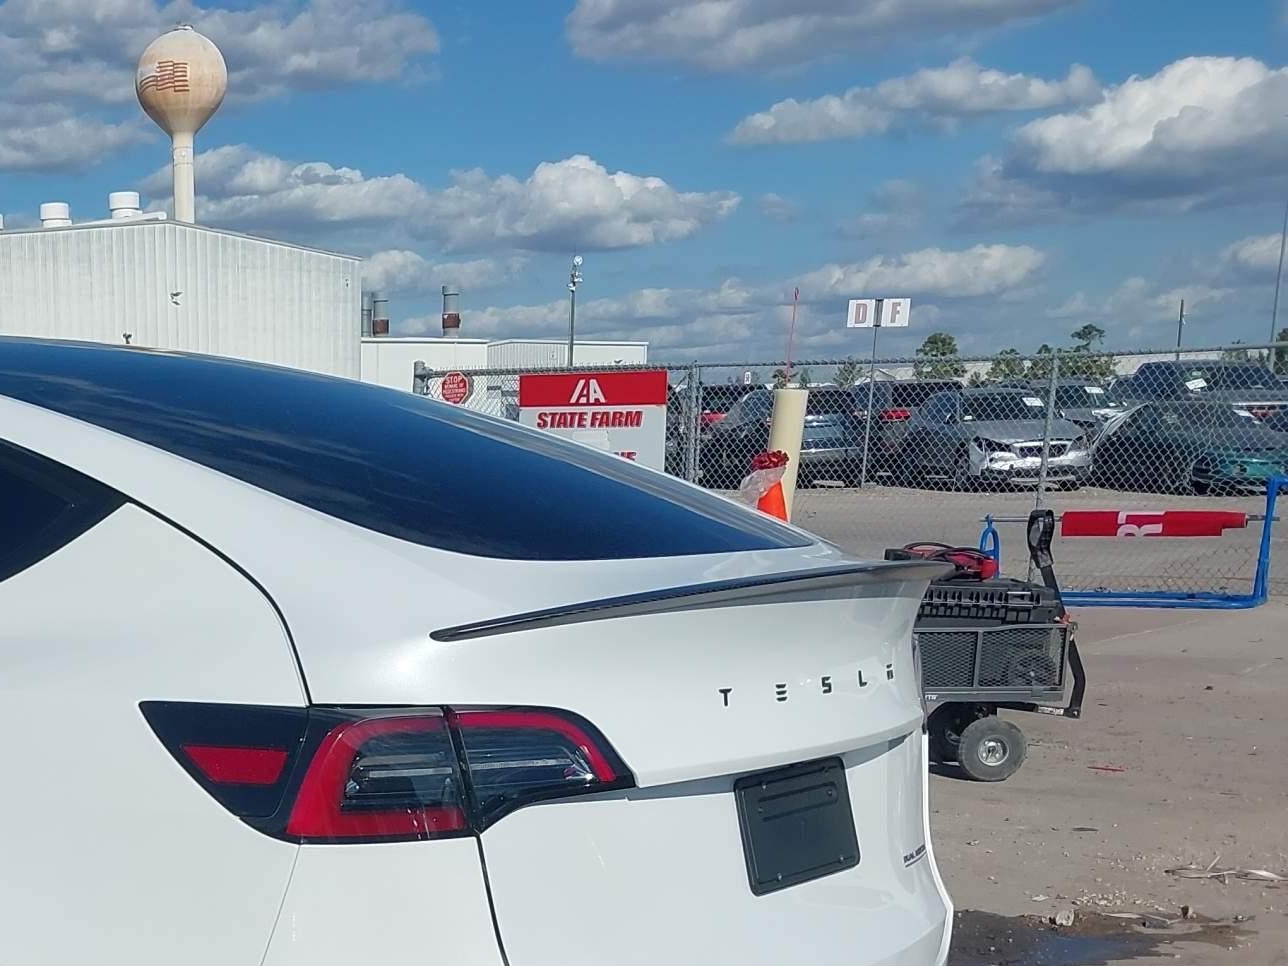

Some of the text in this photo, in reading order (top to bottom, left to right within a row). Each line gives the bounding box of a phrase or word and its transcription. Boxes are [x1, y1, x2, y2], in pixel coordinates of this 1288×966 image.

[854, 301, 902, 324] D F
[445, 375, 463, 385] STOP
[536, 410, 643, 429] STATE FARM
[718, 663, 894, 707] TESLA
